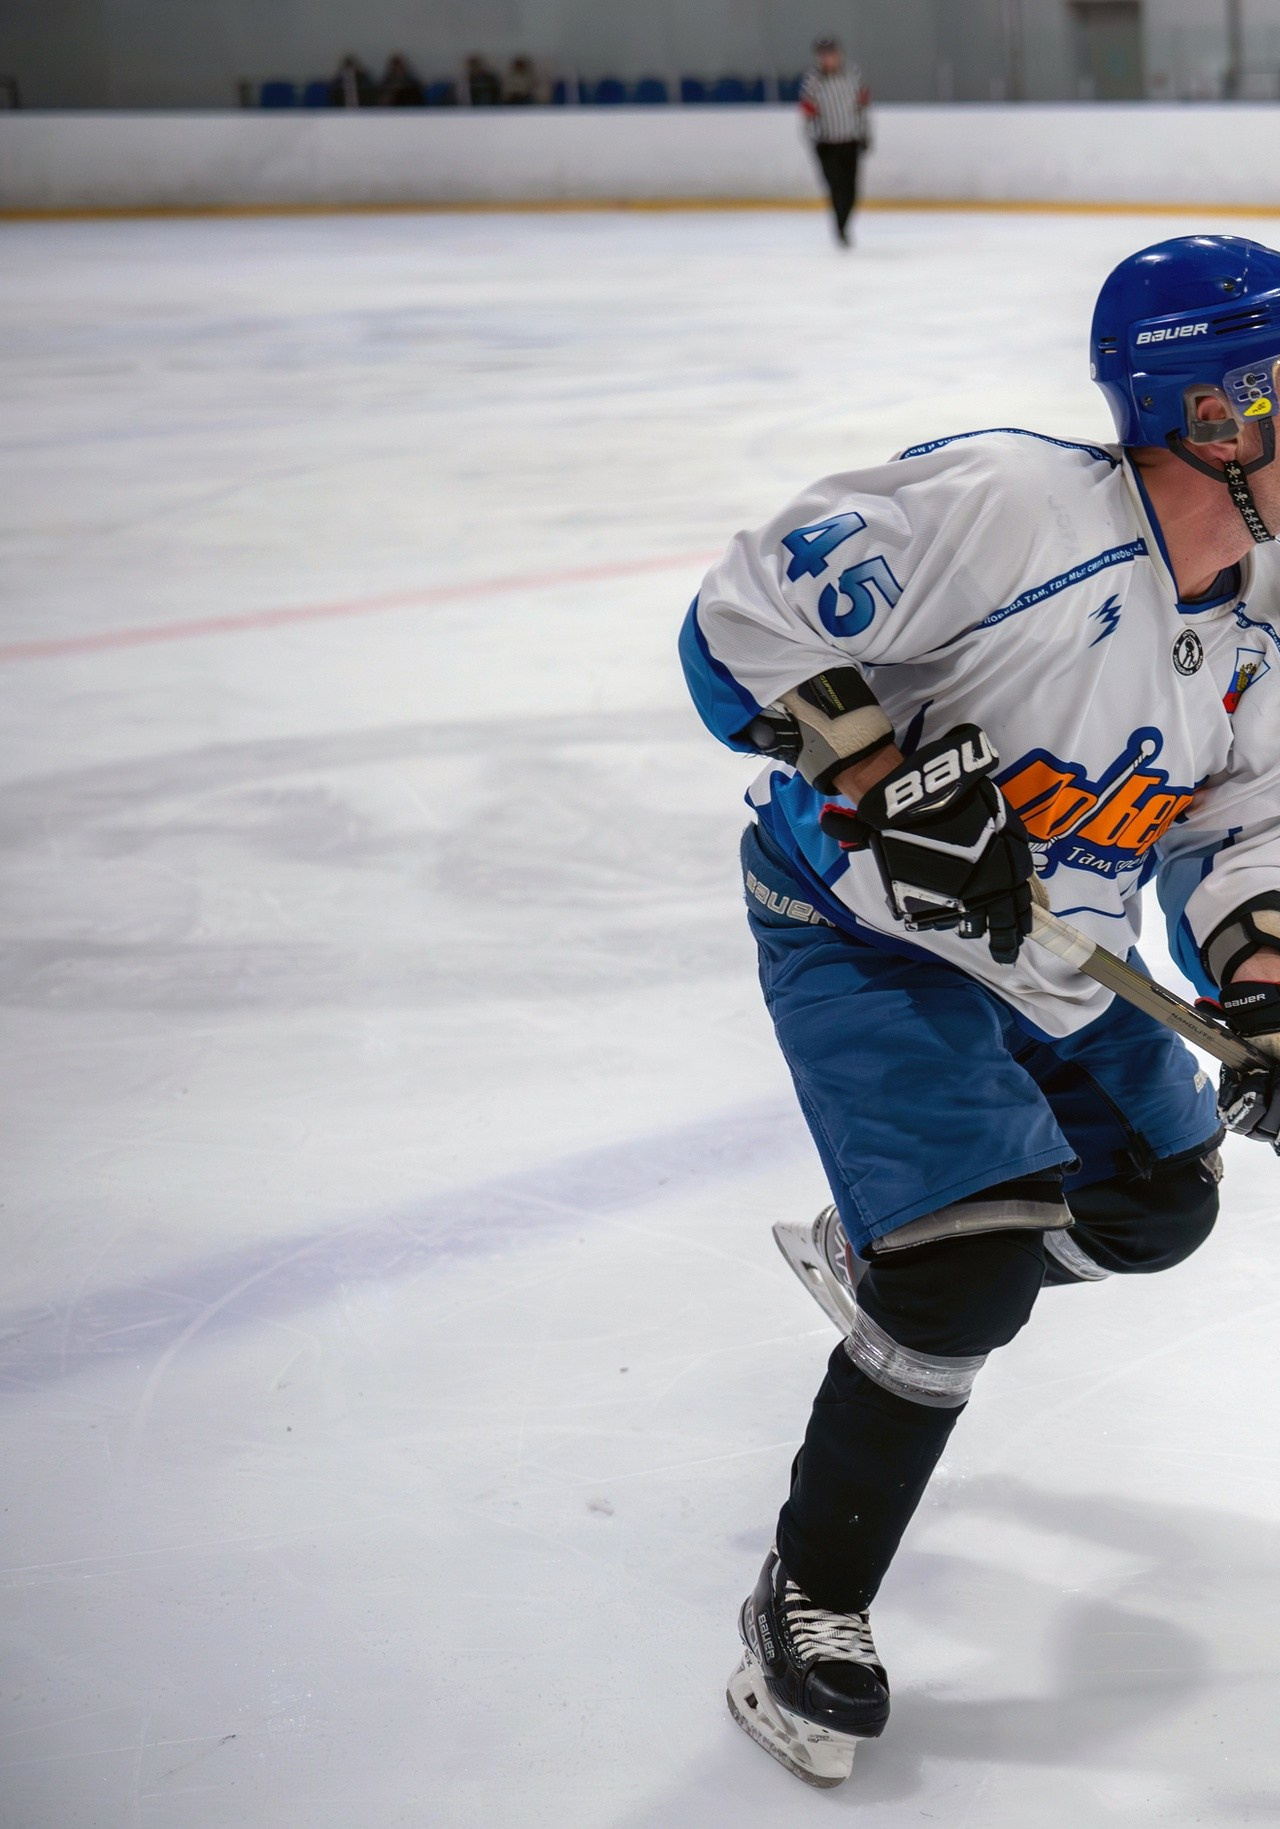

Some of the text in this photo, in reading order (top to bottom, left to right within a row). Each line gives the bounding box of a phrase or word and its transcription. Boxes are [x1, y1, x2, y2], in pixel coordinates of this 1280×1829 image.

[1136, 322, 1209, 345] BAUER
[781, 511, 903, 638] 45
[1224, 993, 1266, 1009] BAUER
[758, 1614, 776, 1663] BAUER
